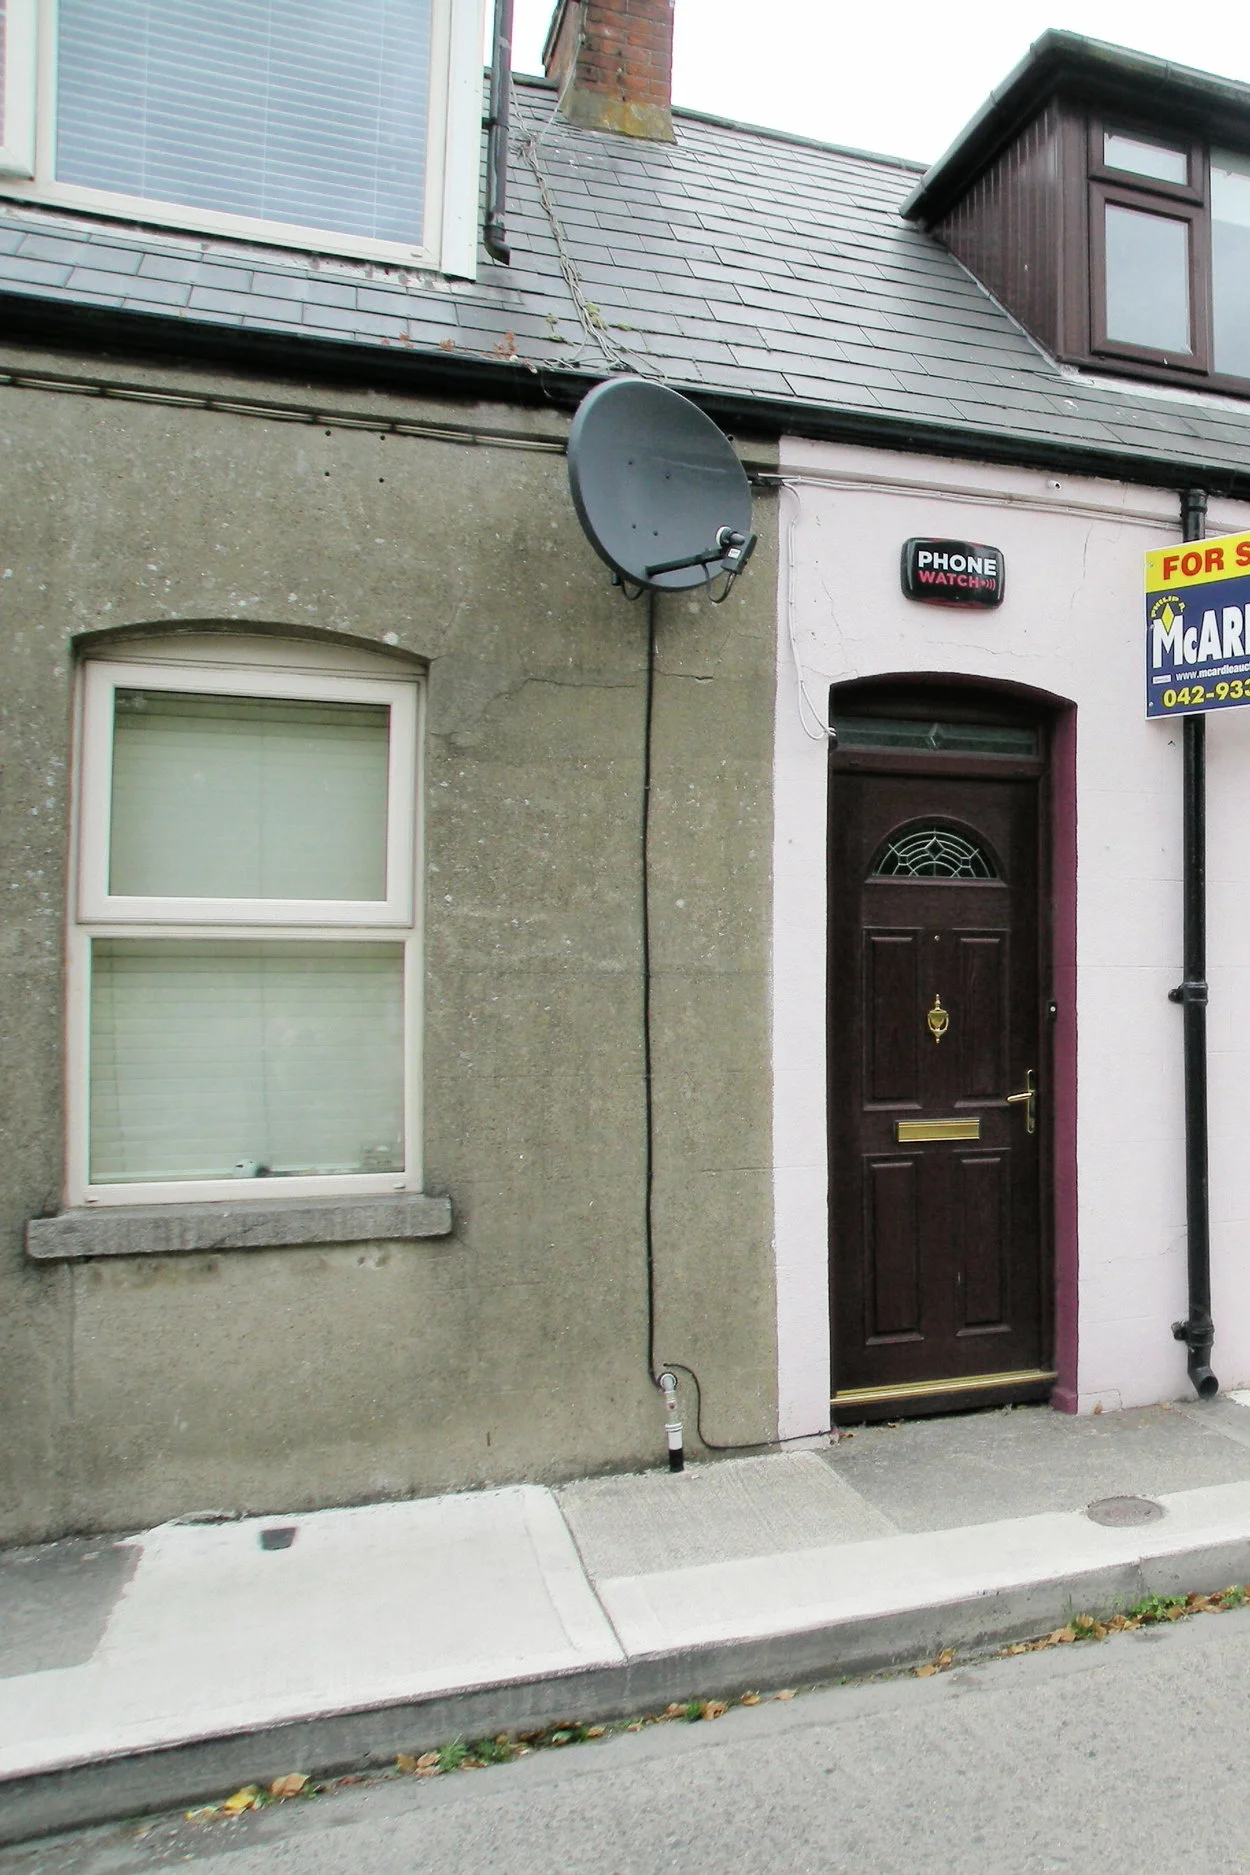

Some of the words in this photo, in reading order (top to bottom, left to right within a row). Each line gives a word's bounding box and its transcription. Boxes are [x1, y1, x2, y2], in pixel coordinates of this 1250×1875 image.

[918, 550, 997, 576] PHONE
[1163, 548, 1224, 581] FOR
[917, 570, 979, 588] WATCH
